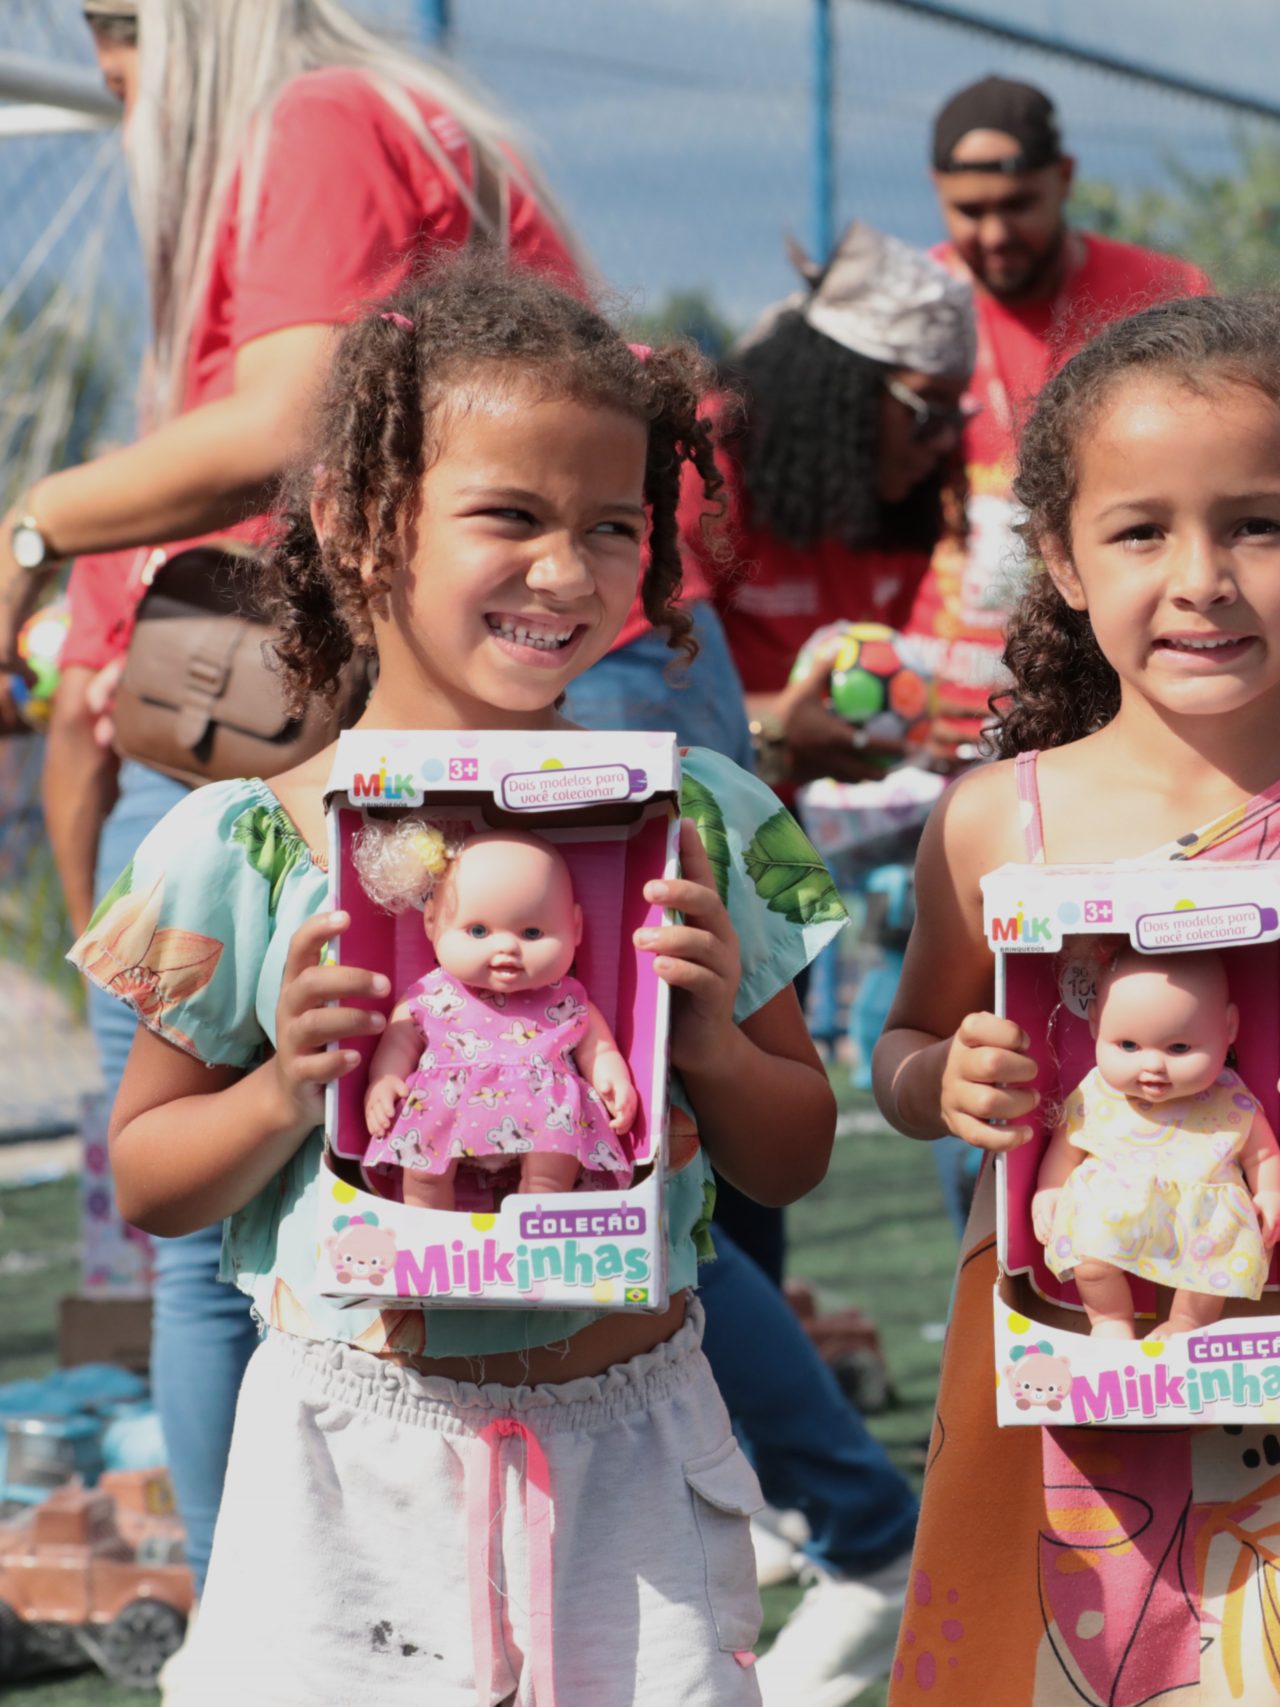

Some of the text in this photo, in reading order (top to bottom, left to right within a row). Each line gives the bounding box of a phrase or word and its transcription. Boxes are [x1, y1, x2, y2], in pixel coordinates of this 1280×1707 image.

[450, 759, 478, 780] 3+
[509, 771, 625, 792] Dois modelos para
[521, 785, 615, 803] você colecionar
[1086, 901, 1112, 920] 3+
[1143, 912, 1256, 933] Dois modelos para
[1155, 926, 1247, 944] você colecionar
[526, 1214, 639, 1235] COLEÇÃO
[395, 1239, 650, 1297] Milkinhas
